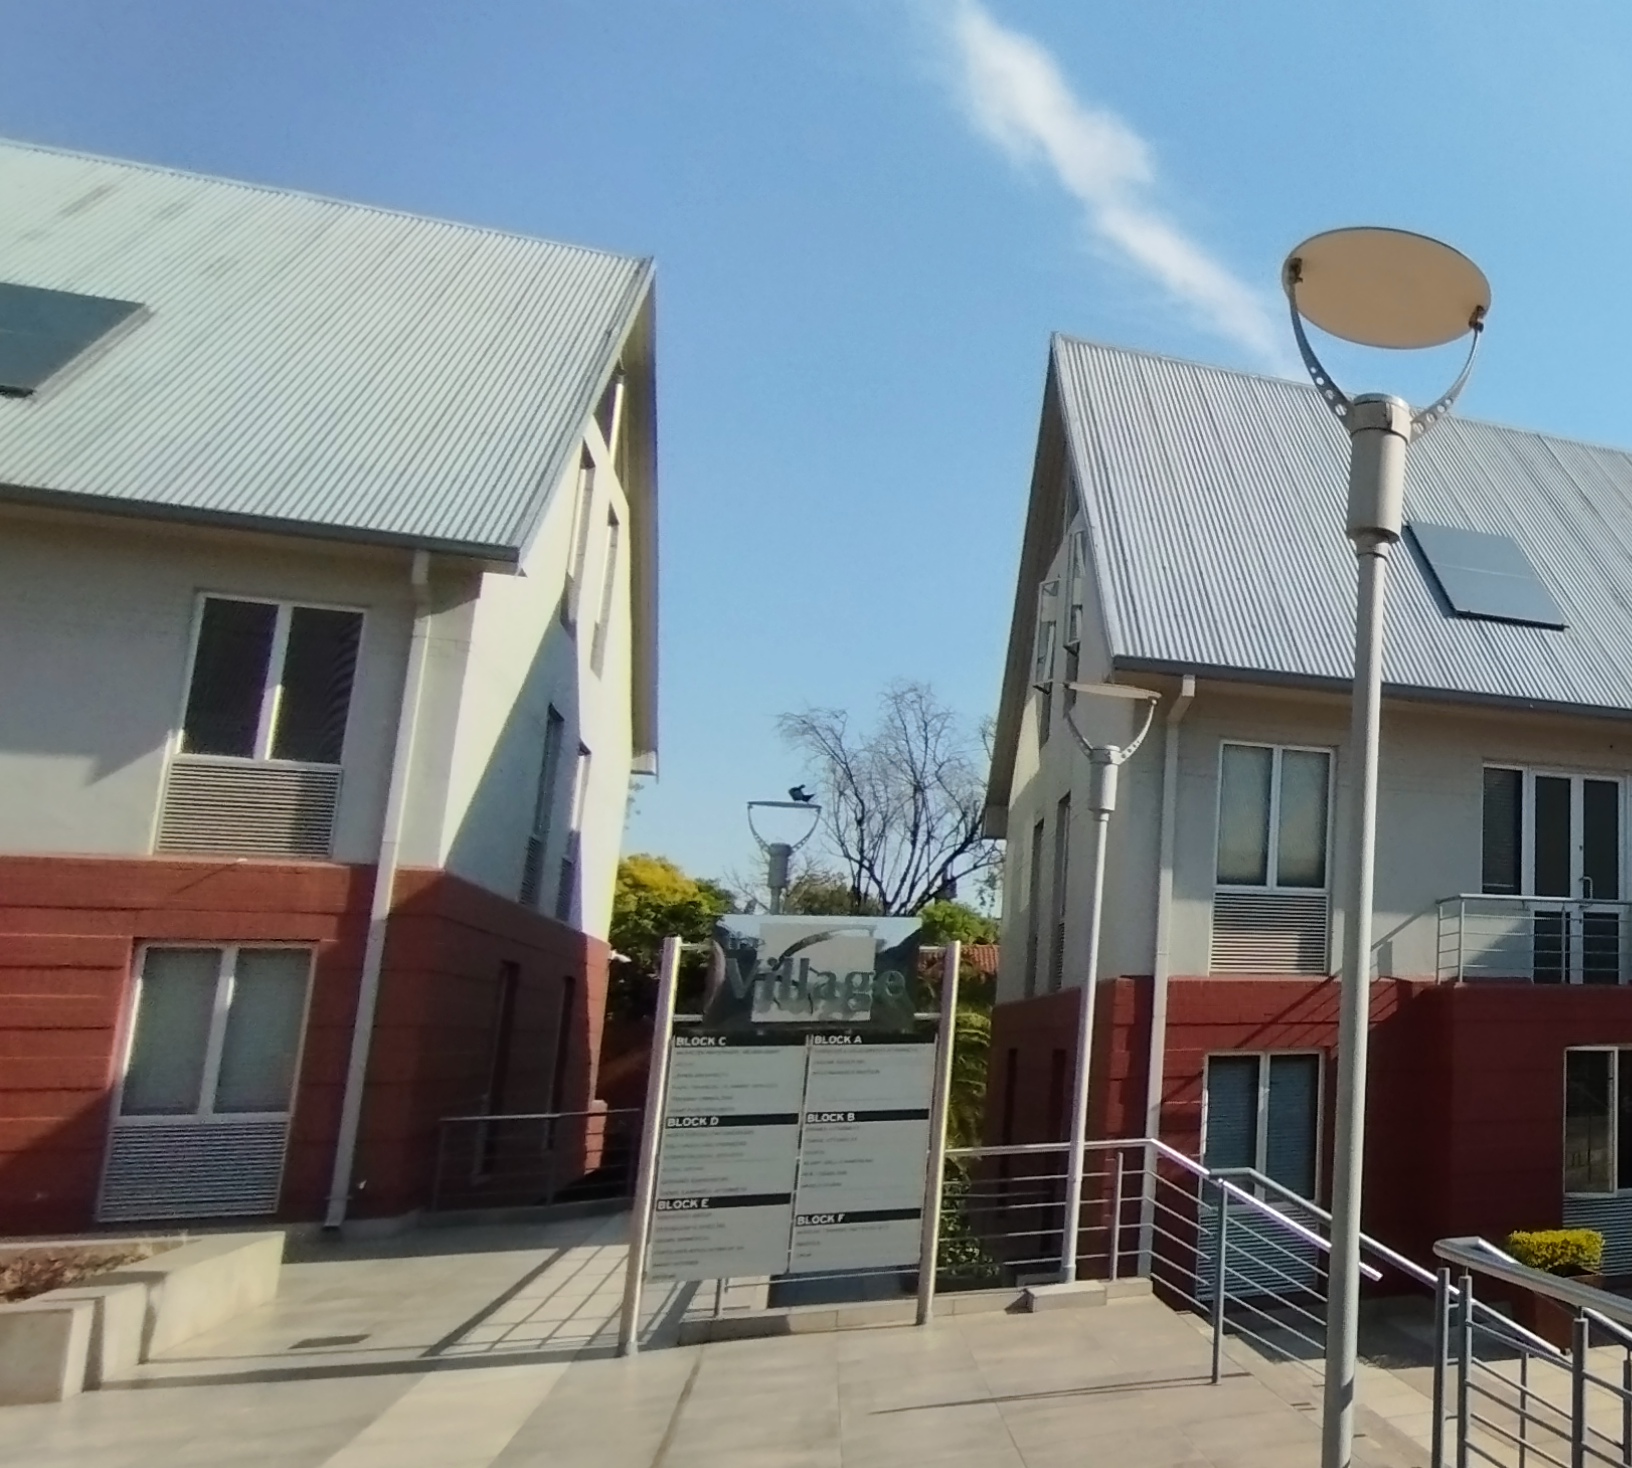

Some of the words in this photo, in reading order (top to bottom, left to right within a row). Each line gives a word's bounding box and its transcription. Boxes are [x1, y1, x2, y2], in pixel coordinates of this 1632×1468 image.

[724, 957, 906, 1012] Village
[676, 1036, 715, 1046] BLOCK
[718, 1036, 727, 1045] C
[814, 1035, 851, 1044] BLOCK
[853, 1035, 863, 1044] A
[667, 1117, 706, 1127] BLOCK
[710, 1117, 719, 1125] D
[807, 1113, 844, 1122] BLOCK
[847, 1113, 855, 1121] B
[658, 1199, 697, 1209] BLOCK
[701, 1199, 709, 1208] E
[797, 1215, 834, 1225] BLOCK
[838, 1214, 845, 1222] F
